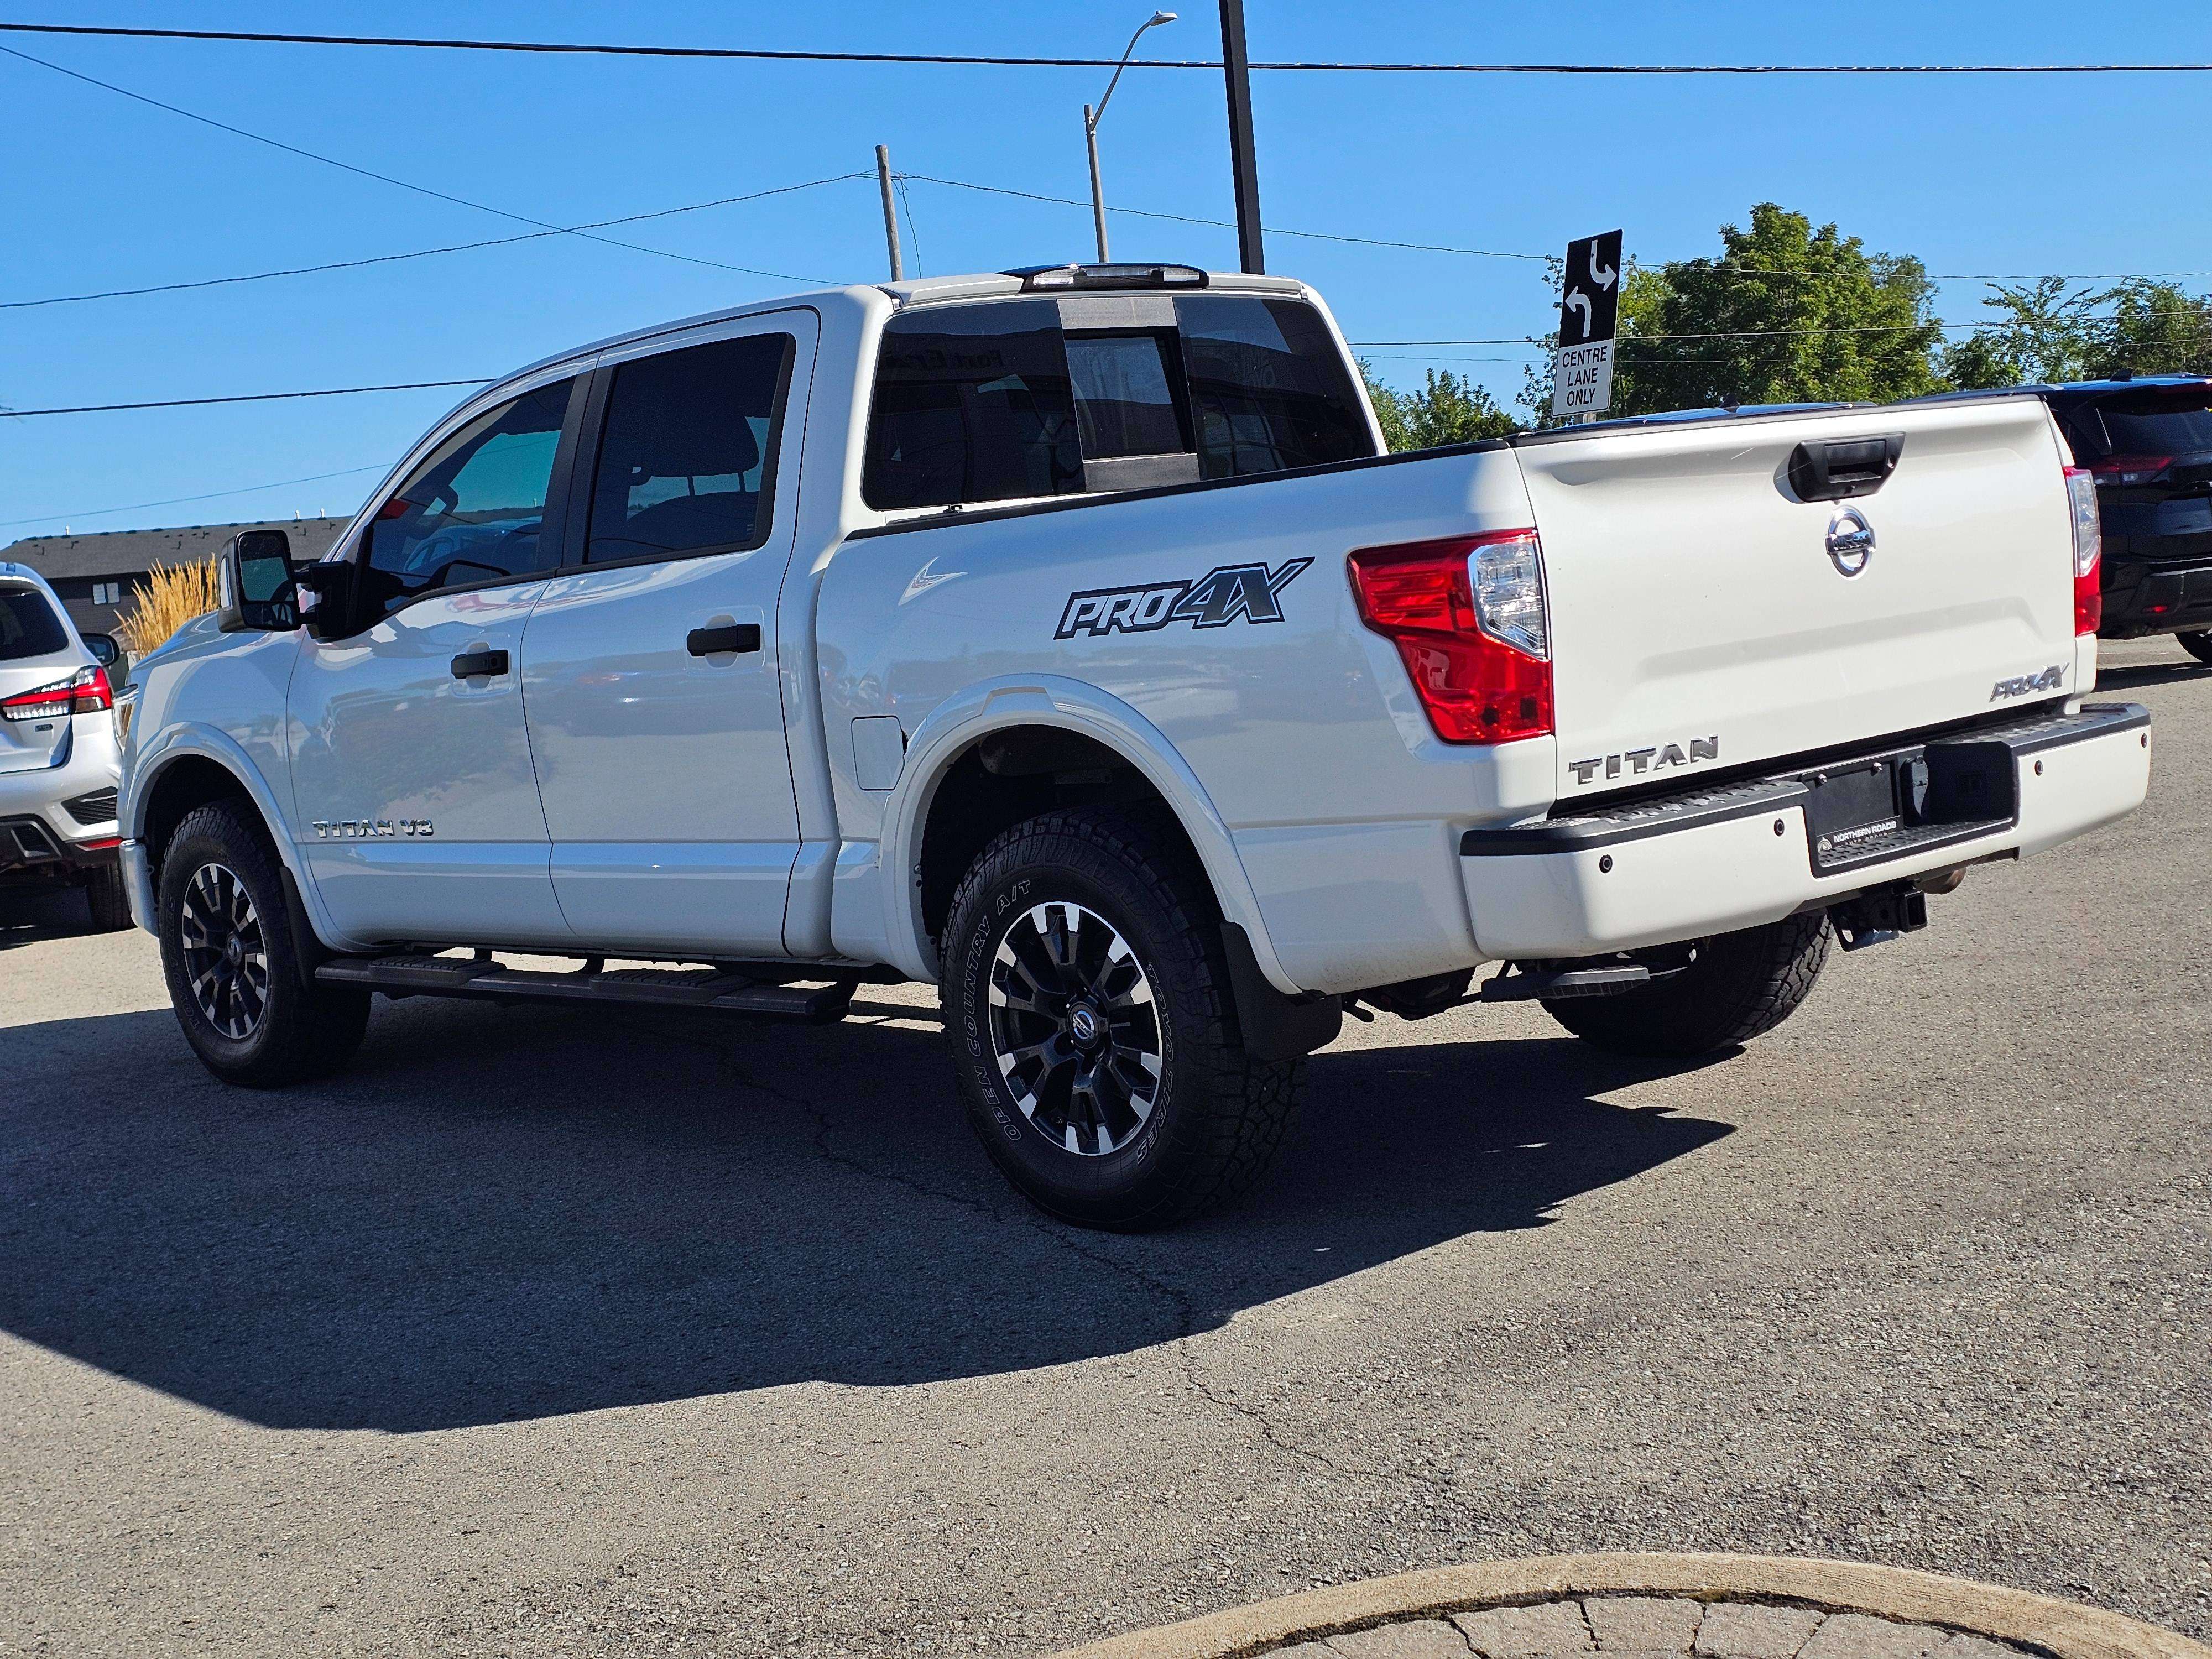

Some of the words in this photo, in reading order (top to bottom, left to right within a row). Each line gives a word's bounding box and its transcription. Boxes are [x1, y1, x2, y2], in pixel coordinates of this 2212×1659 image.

[1562, 346, 1608, 368] CENTRE
[1567, 367, 1598, 387] LANE
[1567, 388, 1596, 407] ONLY
[1053, 556, 1316, 640] PRO4X
[1568, 734, 1718, 785] TITAN
[312, 820, 394, 838] TITAN
[399, 819, 434, 836] V8
[1833, 827, 1871, 843] NORTHERN
[1871, 820, 1897, 833] ROADS
[997, 880, 1030, 916] A/T
[963, 915, 991, 1057] COUNTRY
[1146, 963, 1173, 1062] TOYO
[974, 1066, 1021, 1140] OPEN
[1137, 1068, 1173, 1165] TIRES
